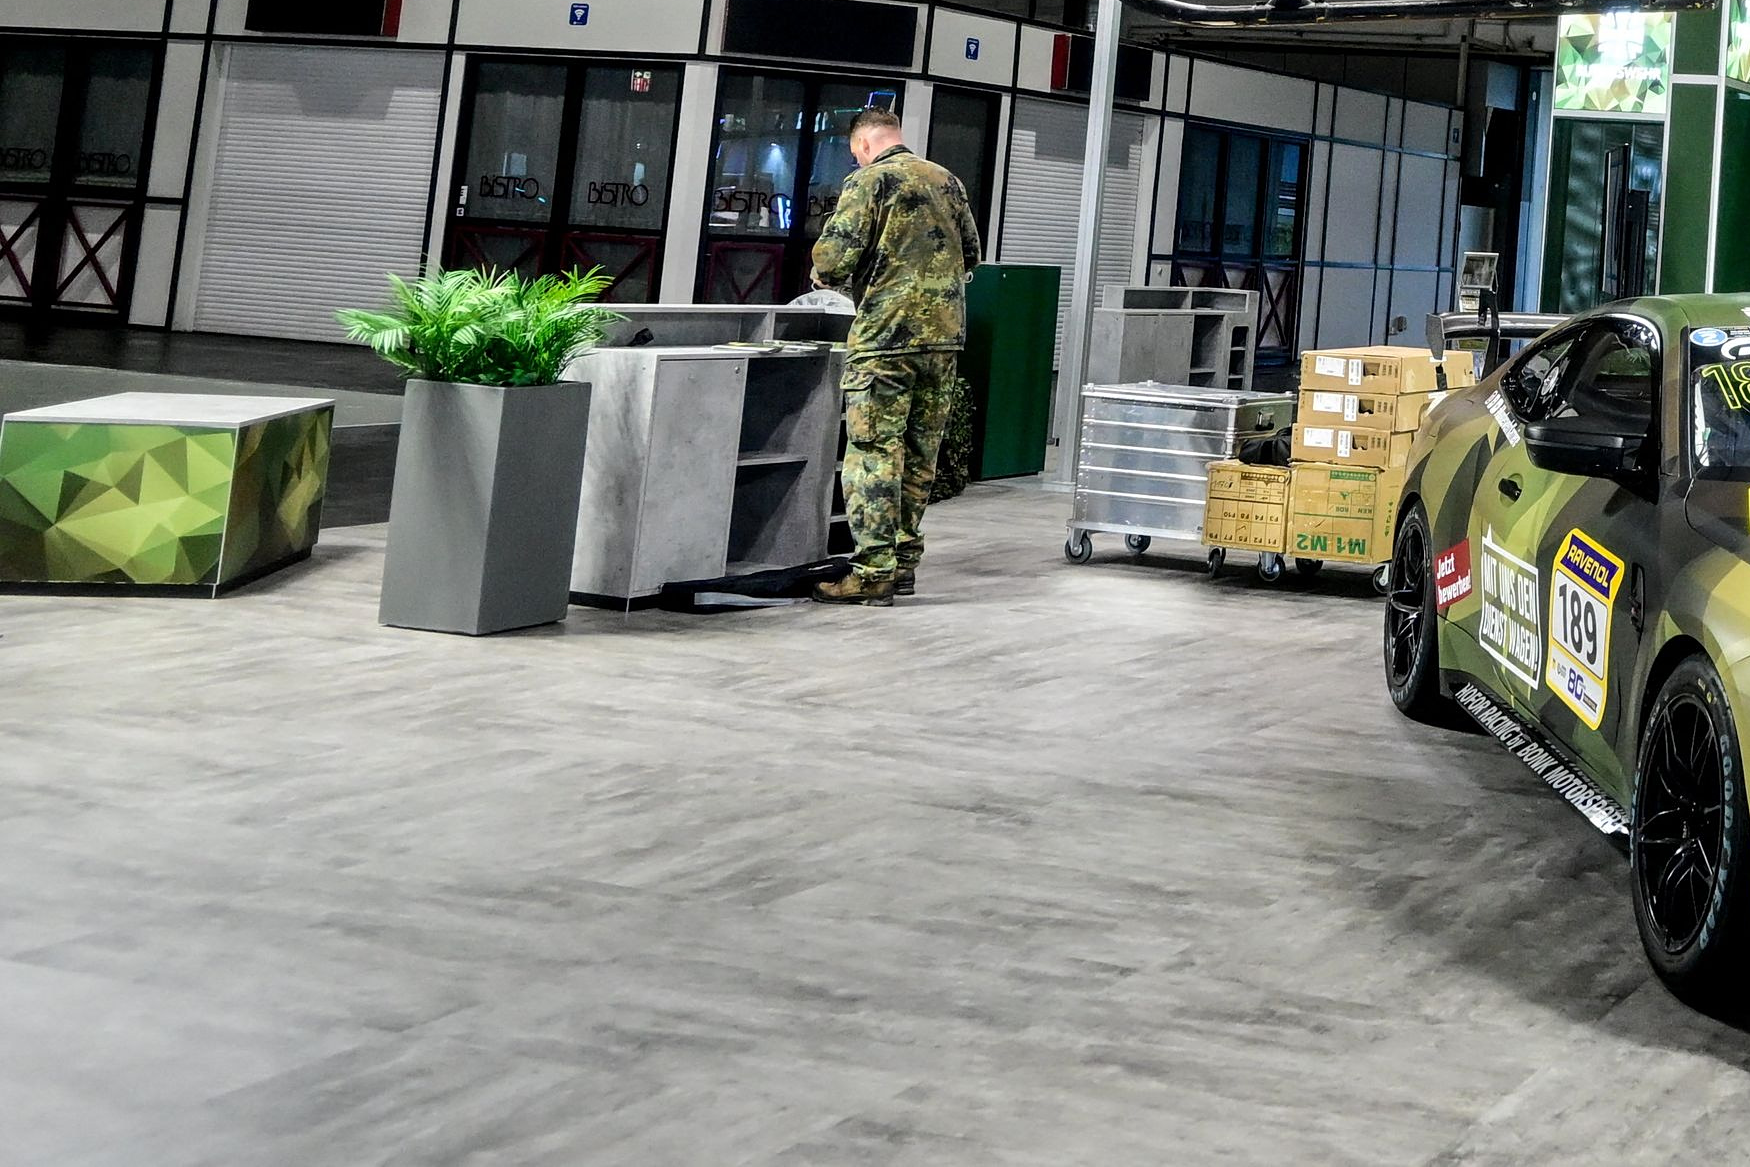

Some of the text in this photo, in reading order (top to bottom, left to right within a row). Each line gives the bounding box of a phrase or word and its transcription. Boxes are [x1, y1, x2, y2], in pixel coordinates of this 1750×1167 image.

[1296, 533, 1366, 555] M1 M2
[1436, 552, 1455, 580] Jetzt
[1567, 545, 1611, 589] RAVENOL
[1483, 552, 1537, 624] MIT UNS DEN
[1482, 601, 1538, 672] DIENST WAGEN!
[1558, 583, 1598, 666] 189
[1455, 682, 1488, 717] HOFOR
[1477, 701, 1521, 742] RACING
[1508, 733, 1526, 753] by
[1516, 742, 1558, 775] BONK
